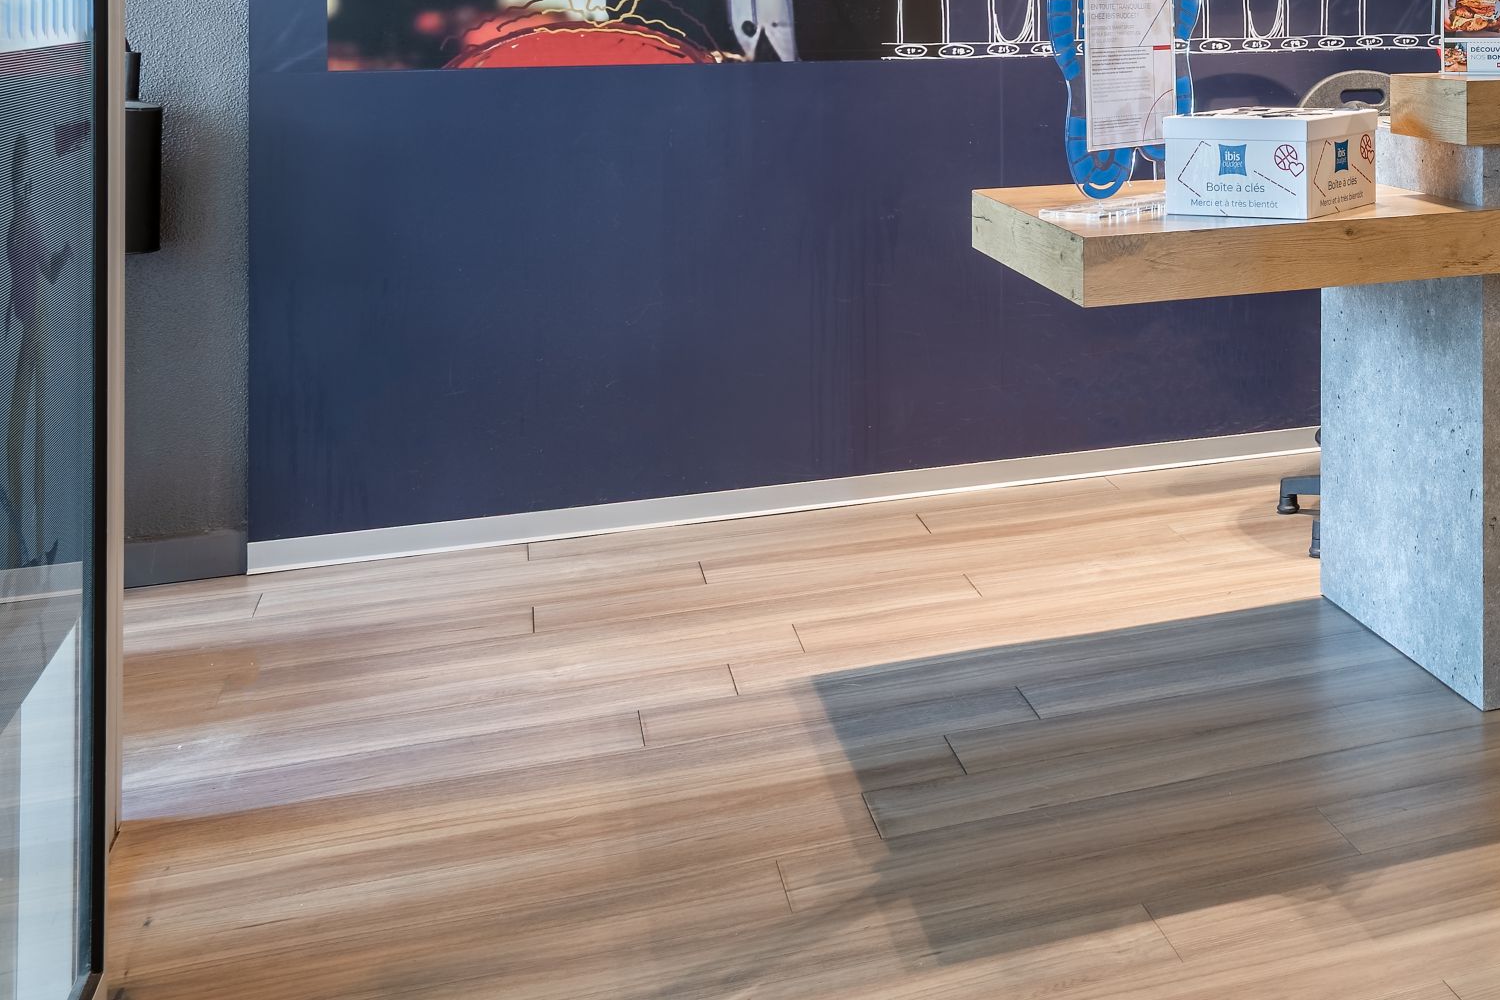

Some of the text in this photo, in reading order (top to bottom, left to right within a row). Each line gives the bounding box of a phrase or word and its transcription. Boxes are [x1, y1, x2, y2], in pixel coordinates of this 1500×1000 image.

[1224, 150, 1241, 161] ibis
[1337, 148, 1346, 158] ibis
[1222, 160, 1243, 169] budget
[1206, 182, 1265, 193] Boîte à clés
[1328, 177, 1358, 191] Boîte à clés
[1190, 199, 1279, 209] Merci et à très bientôt
